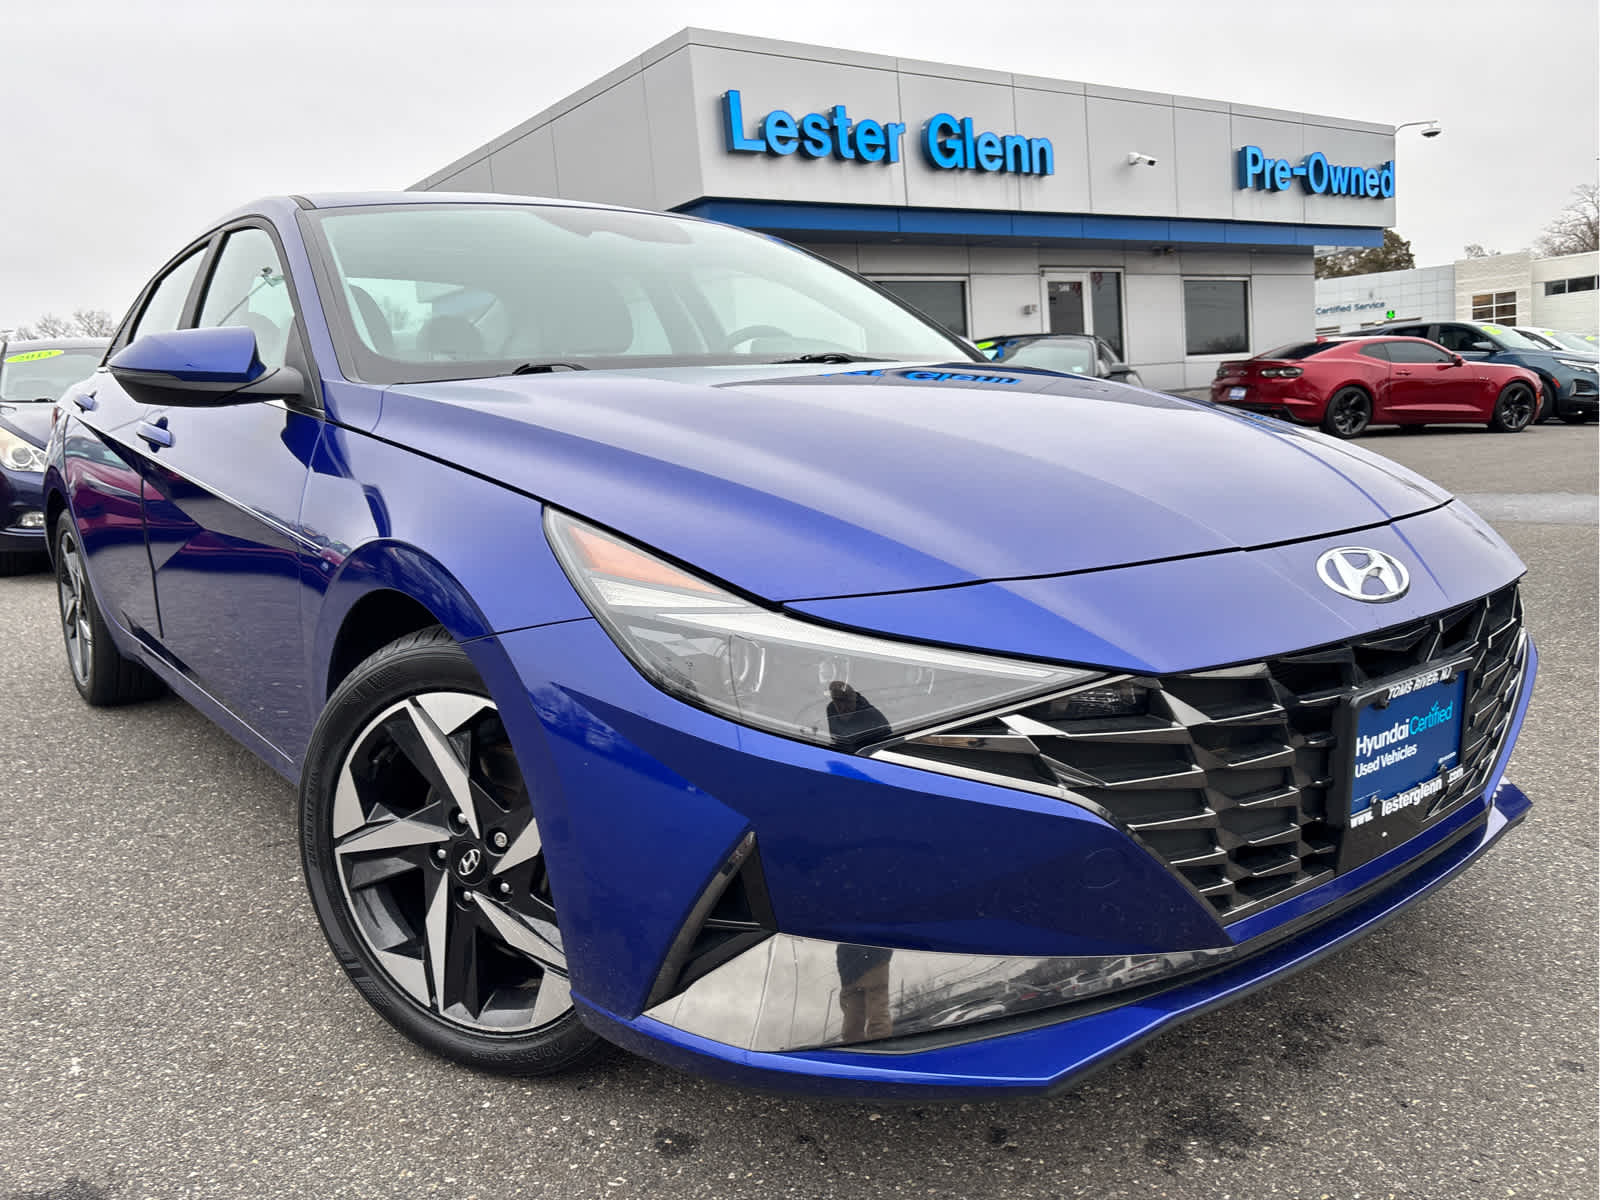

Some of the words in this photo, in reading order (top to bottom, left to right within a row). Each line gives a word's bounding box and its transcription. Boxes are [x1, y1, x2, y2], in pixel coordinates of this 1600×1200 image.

[721, 90, 905, 163] Lester
[922, 113, 1054, 176] Glenn
[1238, 145, 1394, 198] Pre-Owned
[1315, 303, 1352, 315] Certified
[1354, 301, 1385, 310] Service
[1388, 681, 1413, 700] TOMS
[1440, 666, 1453, 680] NJ
[1354, 754, 1380, 778] Used
[1380, 744, 1418, 768] Vehicles
[1381, 778, 1443, 816] lesterglenn
[1447, 767, 1464, 783] .com
